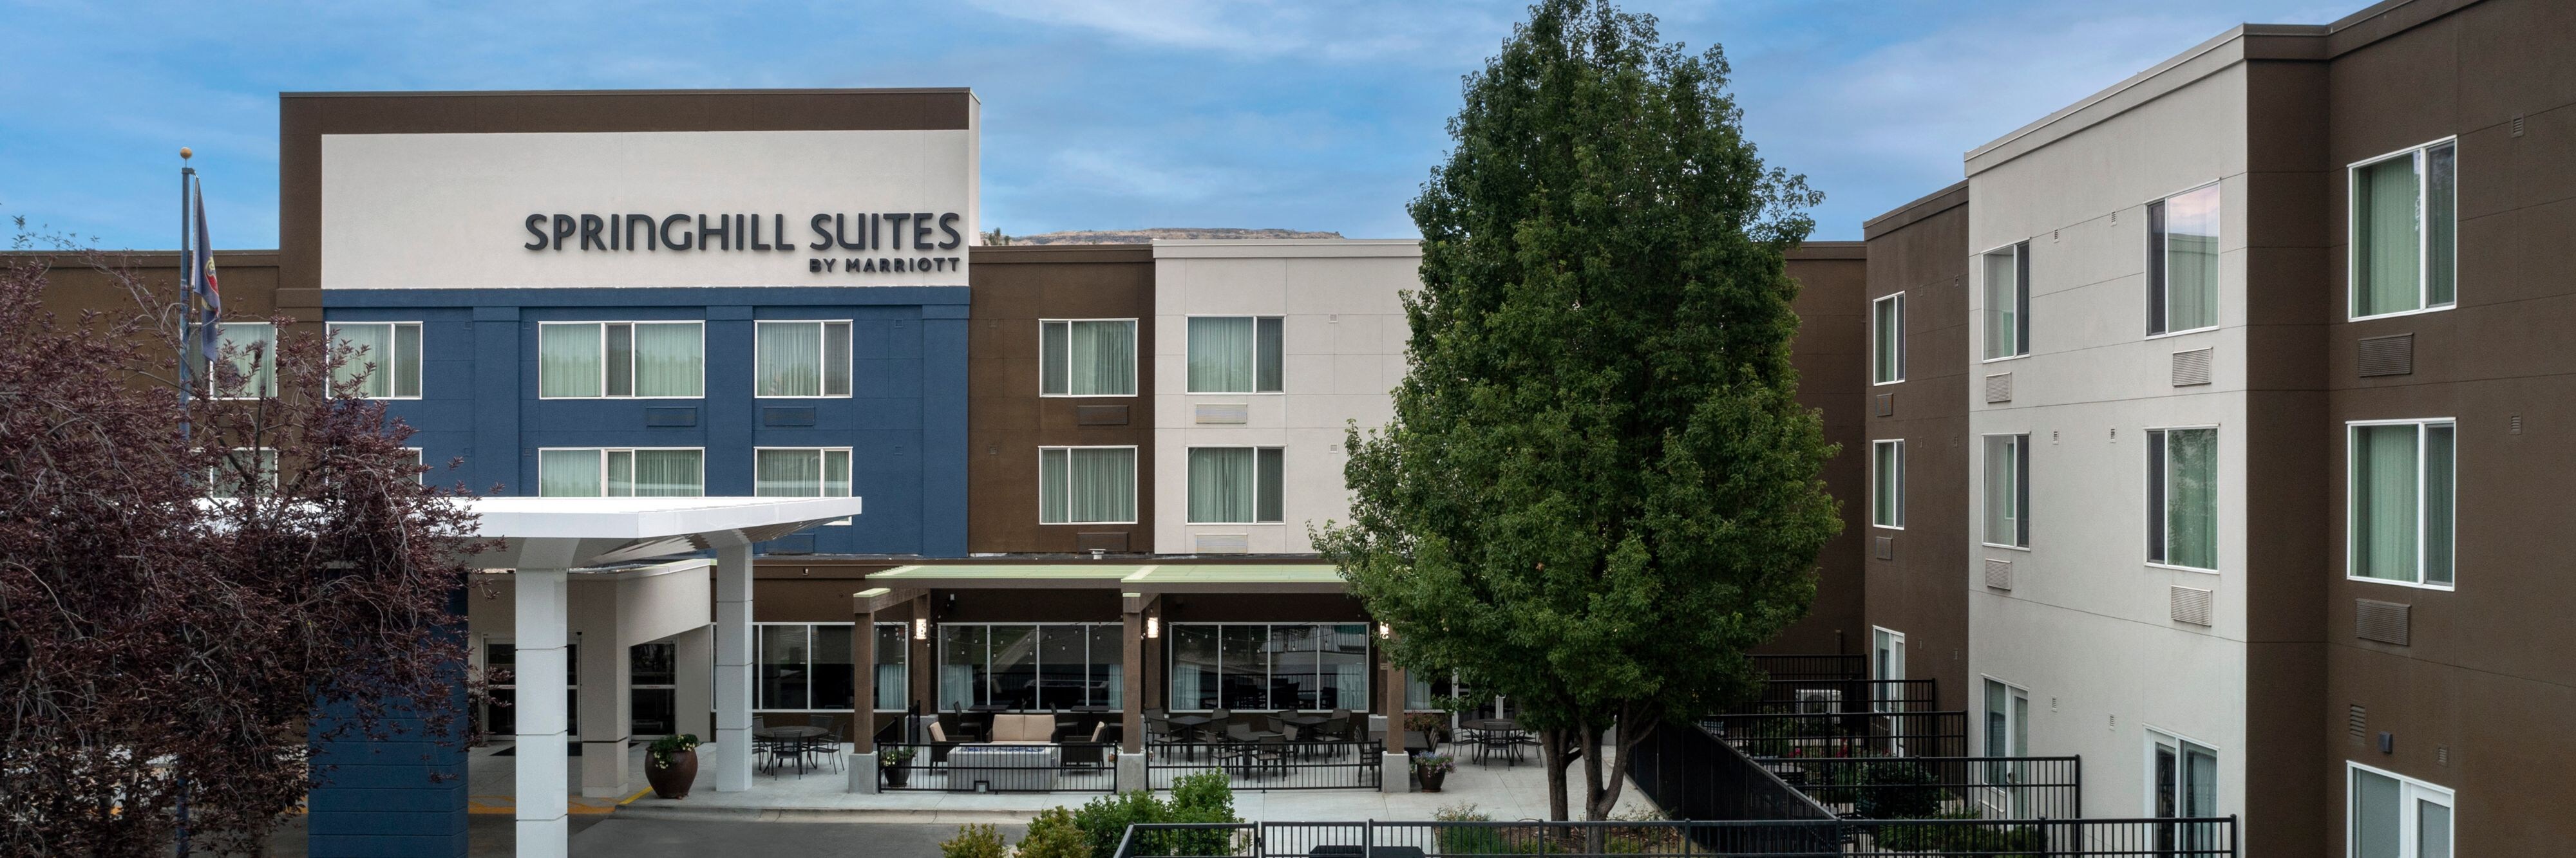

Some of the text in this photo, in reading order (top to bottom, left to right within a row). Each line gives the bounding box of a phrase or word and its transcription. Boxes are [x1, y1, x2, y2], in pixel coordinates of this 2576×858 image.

[524, 212, 961, 252] SPRINGHILL SUITES
[809, 257, 960, 274] BY MARRIOTT
